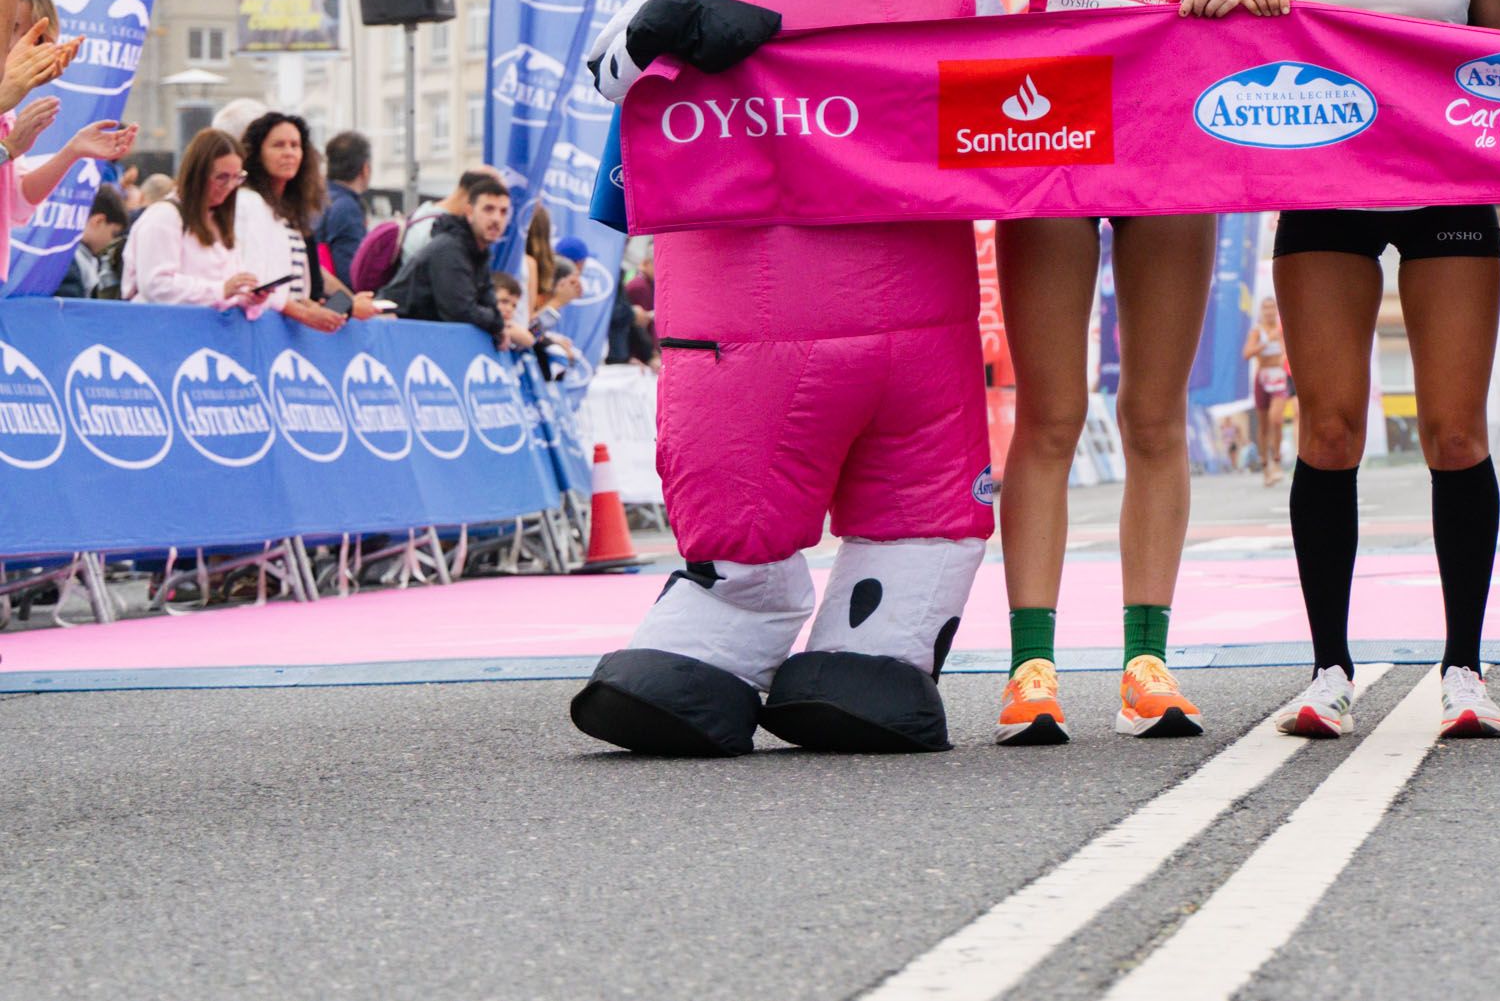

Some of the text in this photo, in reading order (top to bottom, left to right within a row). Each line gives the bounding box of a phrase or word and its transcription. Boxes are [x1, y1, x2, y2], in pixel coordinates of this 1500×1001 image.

[1236, 90, 1357, 101] CENTRAL LECHERA
[661, 95, 860, 143] OYSHO
[1209, 95, 1365, 128] ASTURIANA
[956, 125, 1096, 154] Santander
[1475, 129, 1497, 148] de
[1437, 231, 1483, 242] OYSHO
[75, 387, 168, 436] ASTURIANA
